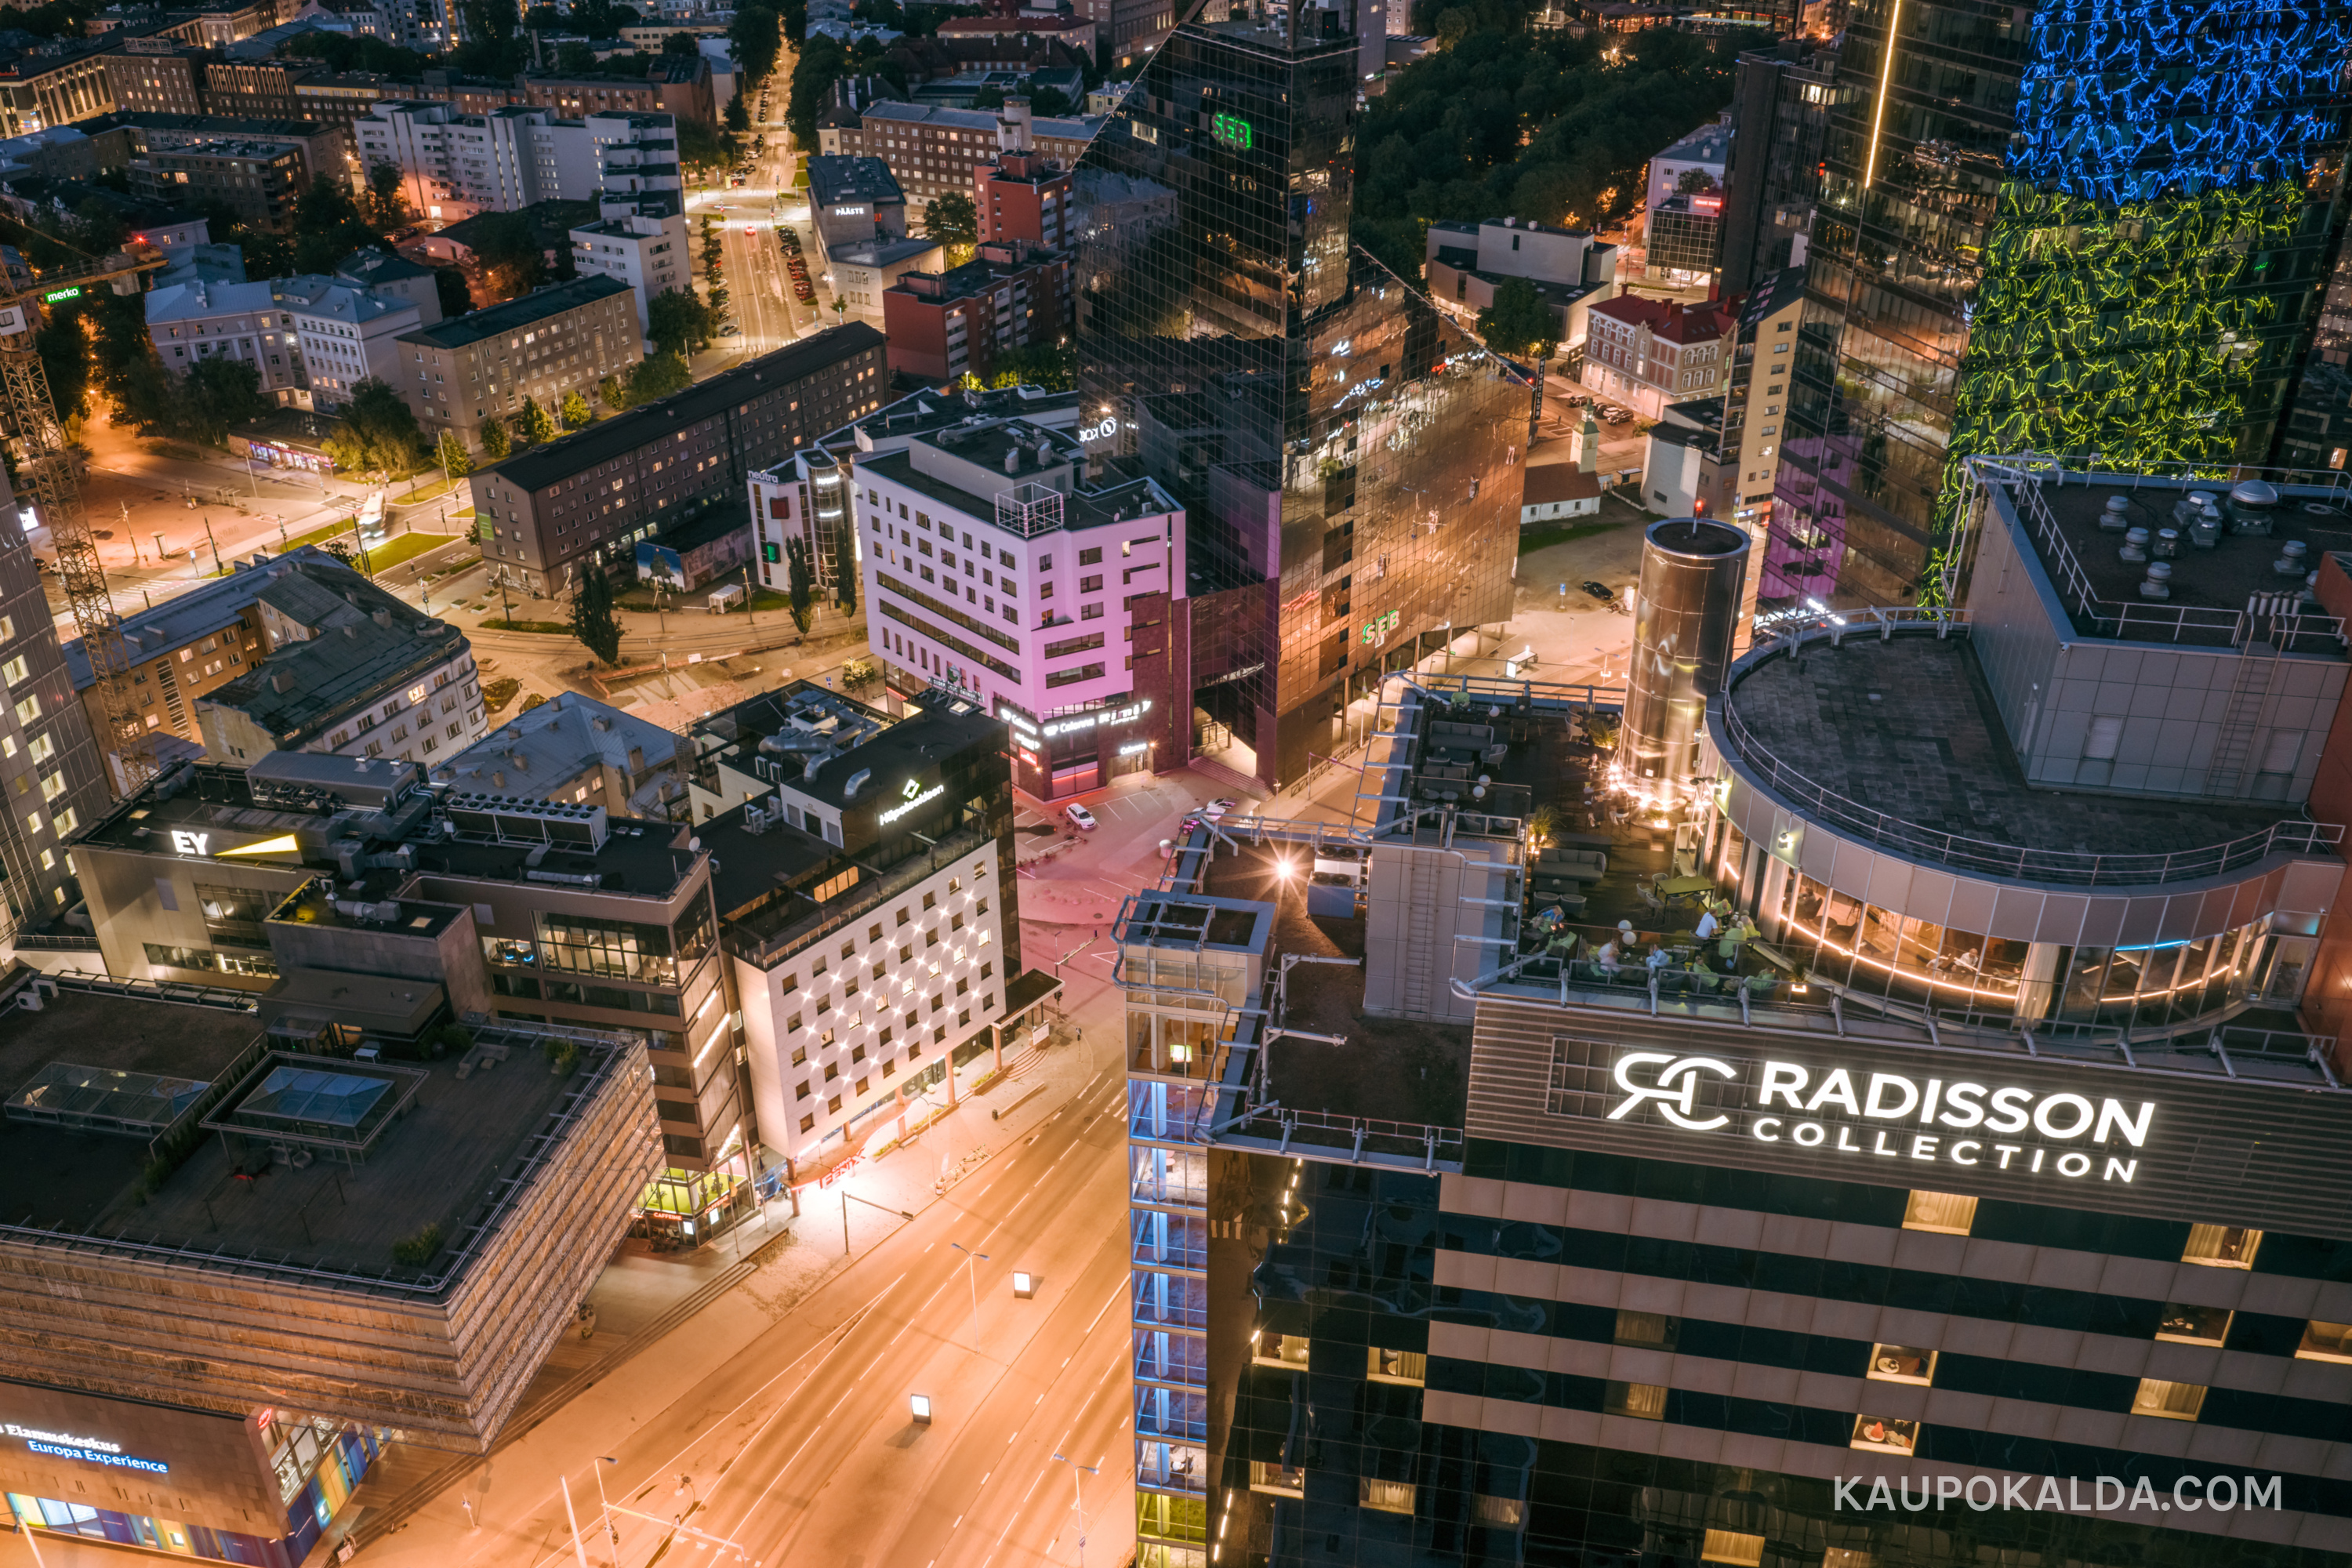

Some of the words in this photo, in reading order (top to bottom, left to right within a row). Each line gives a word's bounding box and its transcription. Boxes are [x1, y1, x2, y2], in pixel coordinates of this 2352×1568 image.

[1210, 113, 1252, 149] SEB
[47, 288, 79, 302] merko
[1536, 361, 1545, 417] NIGHTCLUB
[748, 470, 779, 484] neutra
[1362, 609, 1400, 644] SEB
[1059, 717, 1095, 733] Colonna
[1098, 704, 1140, 724] Rimi
[171, 829, 209, 855] EY
[1758, 1060, 2156, 1148] RADISSON
[1752, 1117, 2139, 1183] COLLECTION
[819, 1147, 866, 1190] FENIX
[652, 1211, 683, 1221] CAFFEINE
[704, 1194, 729, 1214] CAFFEINE
[5, 1424, 121, 1453] Elamuskeskus
[27, 1439, 83, 1459] Europa
[83, 1449, 169, 1474] Experience
